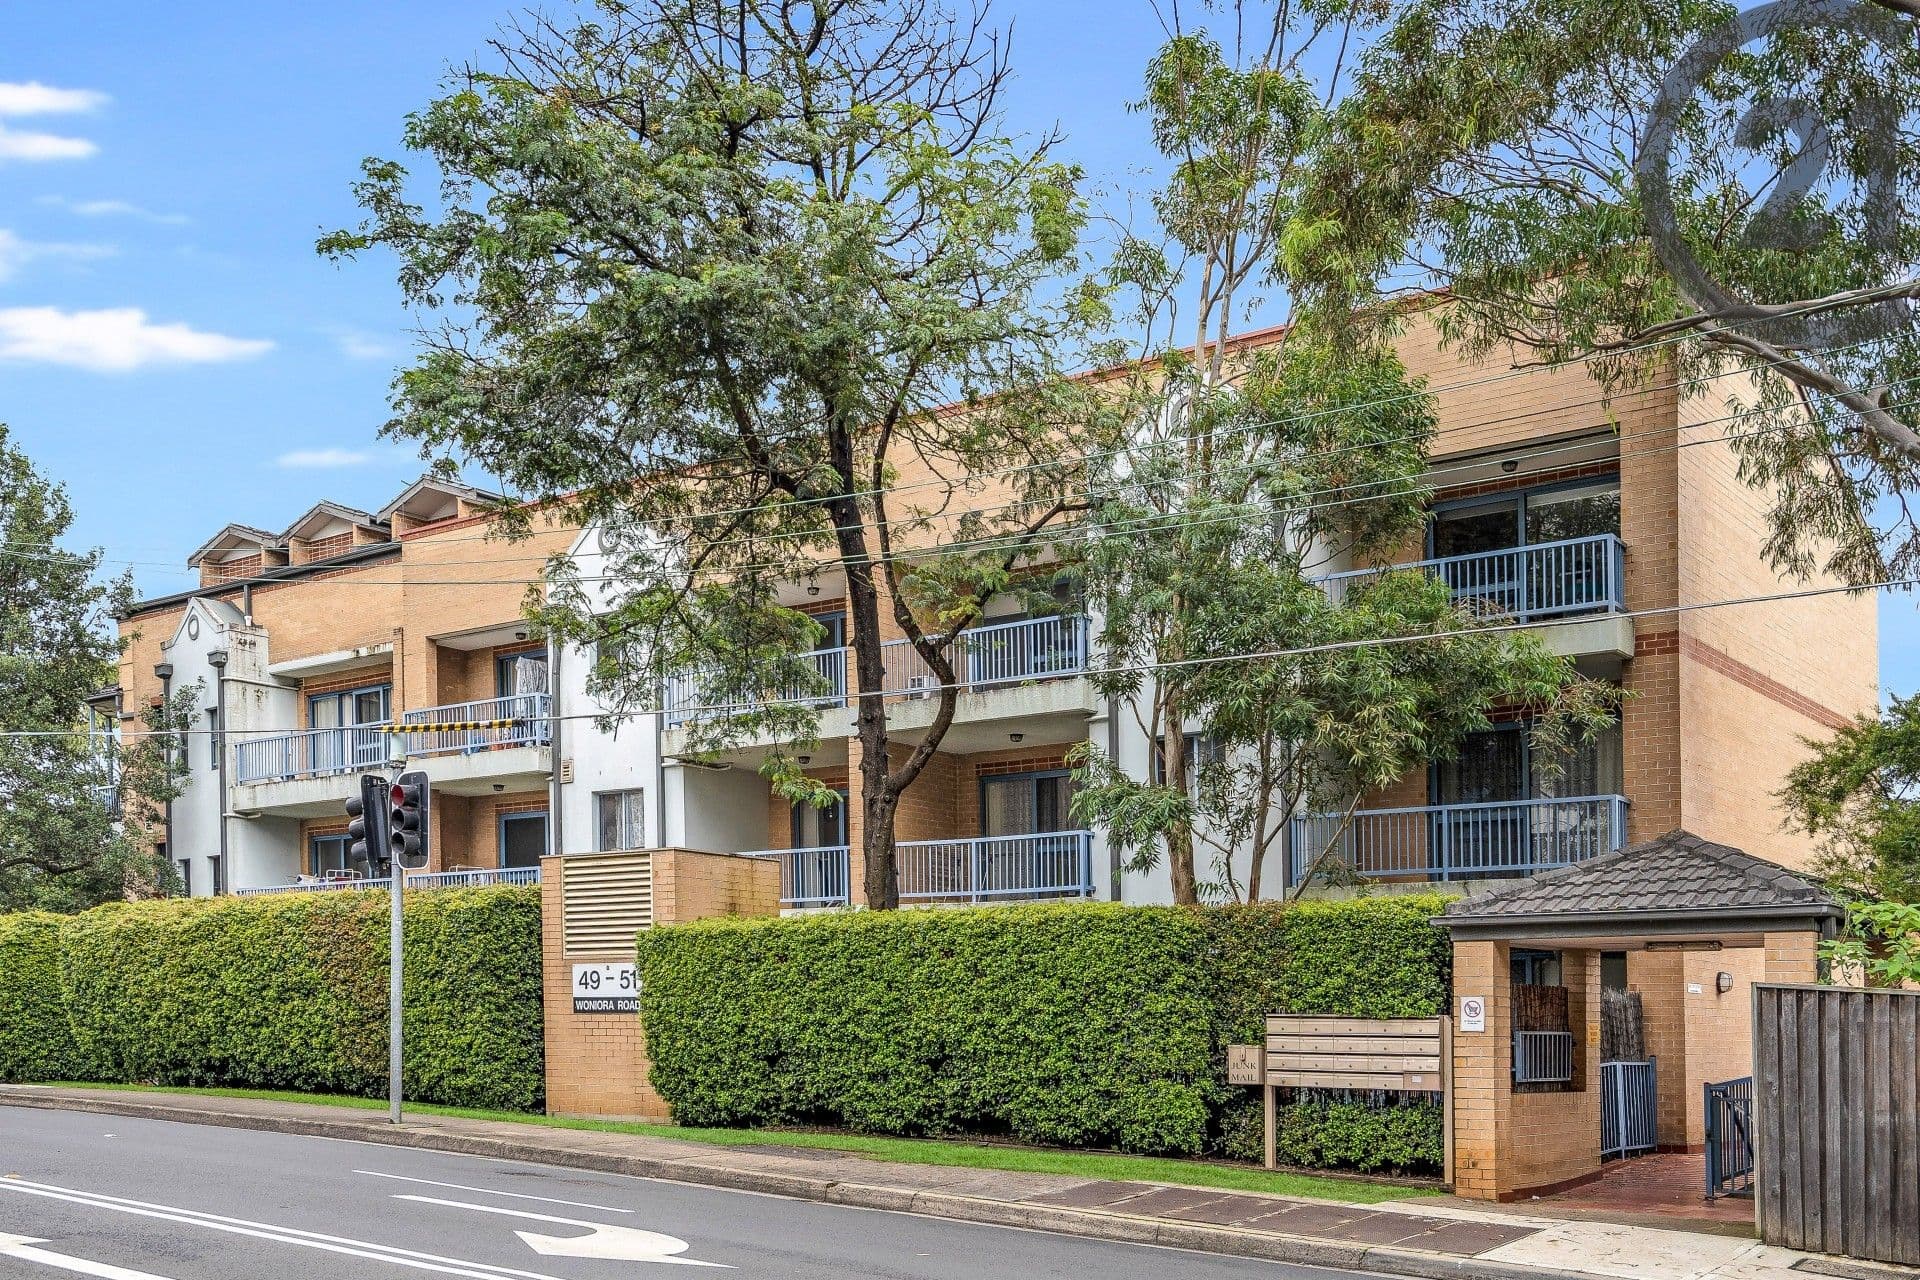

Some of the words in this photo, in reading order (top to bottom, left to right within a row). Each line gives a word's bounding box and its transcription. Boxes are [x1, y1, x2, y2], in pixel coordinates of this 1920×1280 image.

[579, 970, 600, 990] 49
[620, 970, 637, 989] 51
[575, 1000, 614, 1010] WONIORA
[617, 1000, 641, 1010] ROAD
[1231, 1062, 1256, 1070] JUNK
[1231, 1073, 1256, 1081] MAIL
